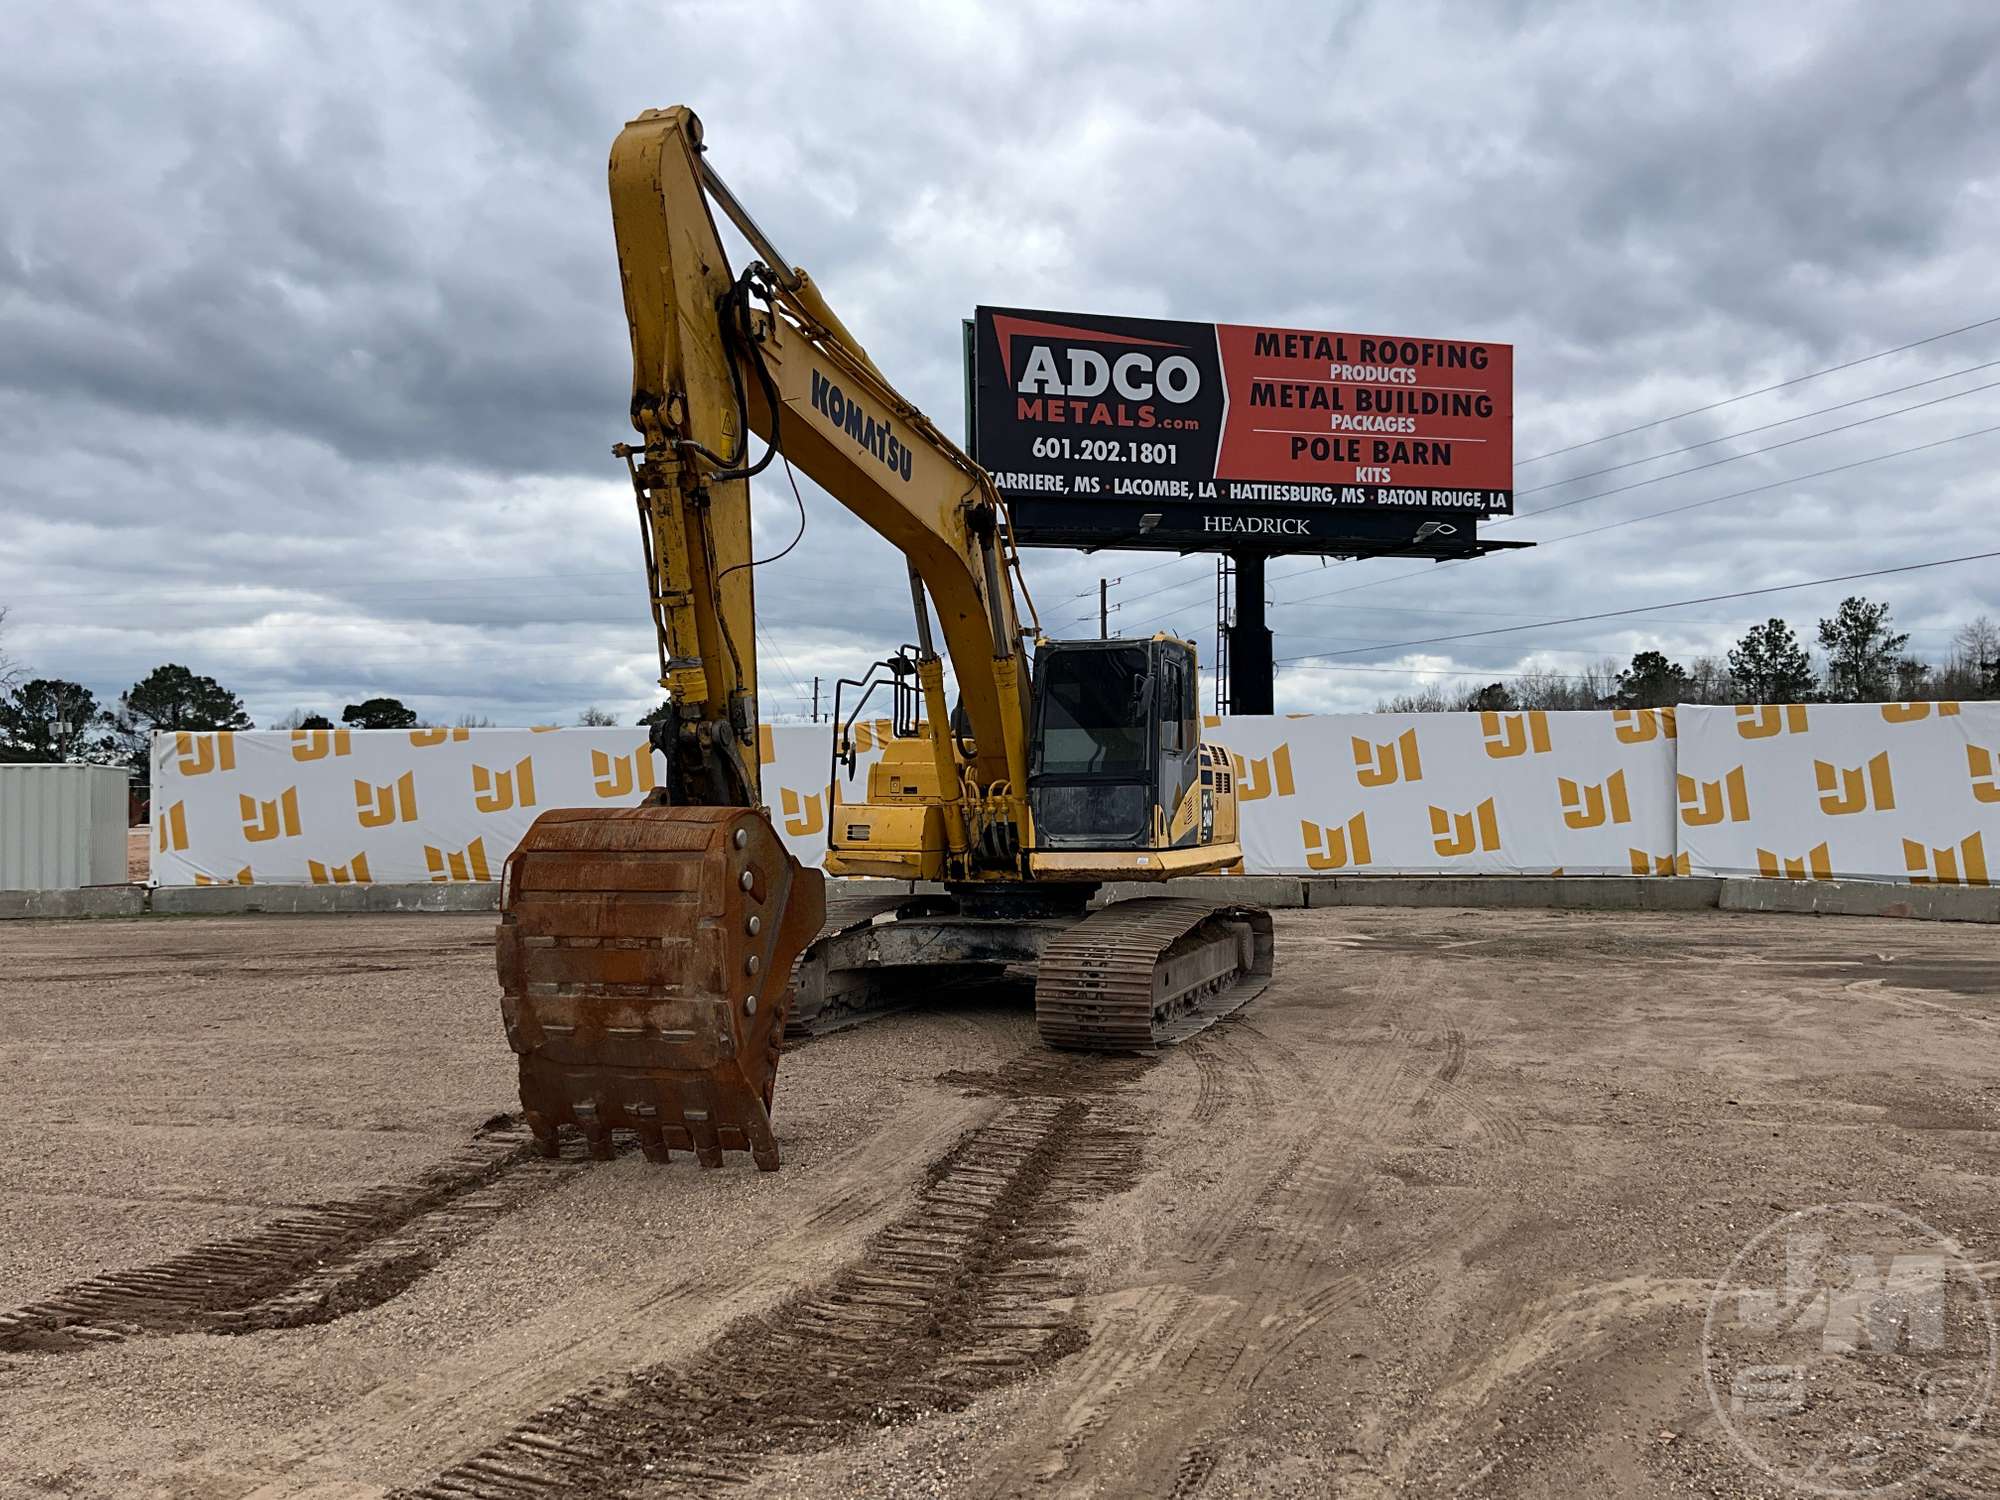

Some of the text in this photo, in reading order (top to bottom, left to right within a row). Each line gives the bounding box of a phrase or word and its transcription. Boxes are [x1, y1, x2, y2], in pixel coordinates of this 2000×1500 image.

[1254, 333, 1489, 369] METAL ROOFING
[1018, 345, 1200, 403] ADCO
[1330, 363, 1417, 384] PRODUCTS
[1250, 382, 1493, 417] METAL BUILDING
[811, 367, 913, 482] KOMATSU
[1331, 414, 1417, 433] PACKAGES
[1032, 437, 1177, 465] 601.202.1801
[1291, 436, 1451, 466] POLE BARN
[1355, 467, 1391, 483] KITS
[1074, 476, 1100, 493] MS
[1114, 478, 1194, 500] LACOMBE,
[1198, 481, 1217, 499] LA
[1230, 483, 1337, 505] HATTIESBURG,
[1341, 488, 1366, 504] MS
[1377, 489, 1427, 506] BATON
[1431, 491, 1486, 510] ROUGE,
[1490, 493, 1507, 508] LA
[1203, 515, 1311, 535] HEADRICK
